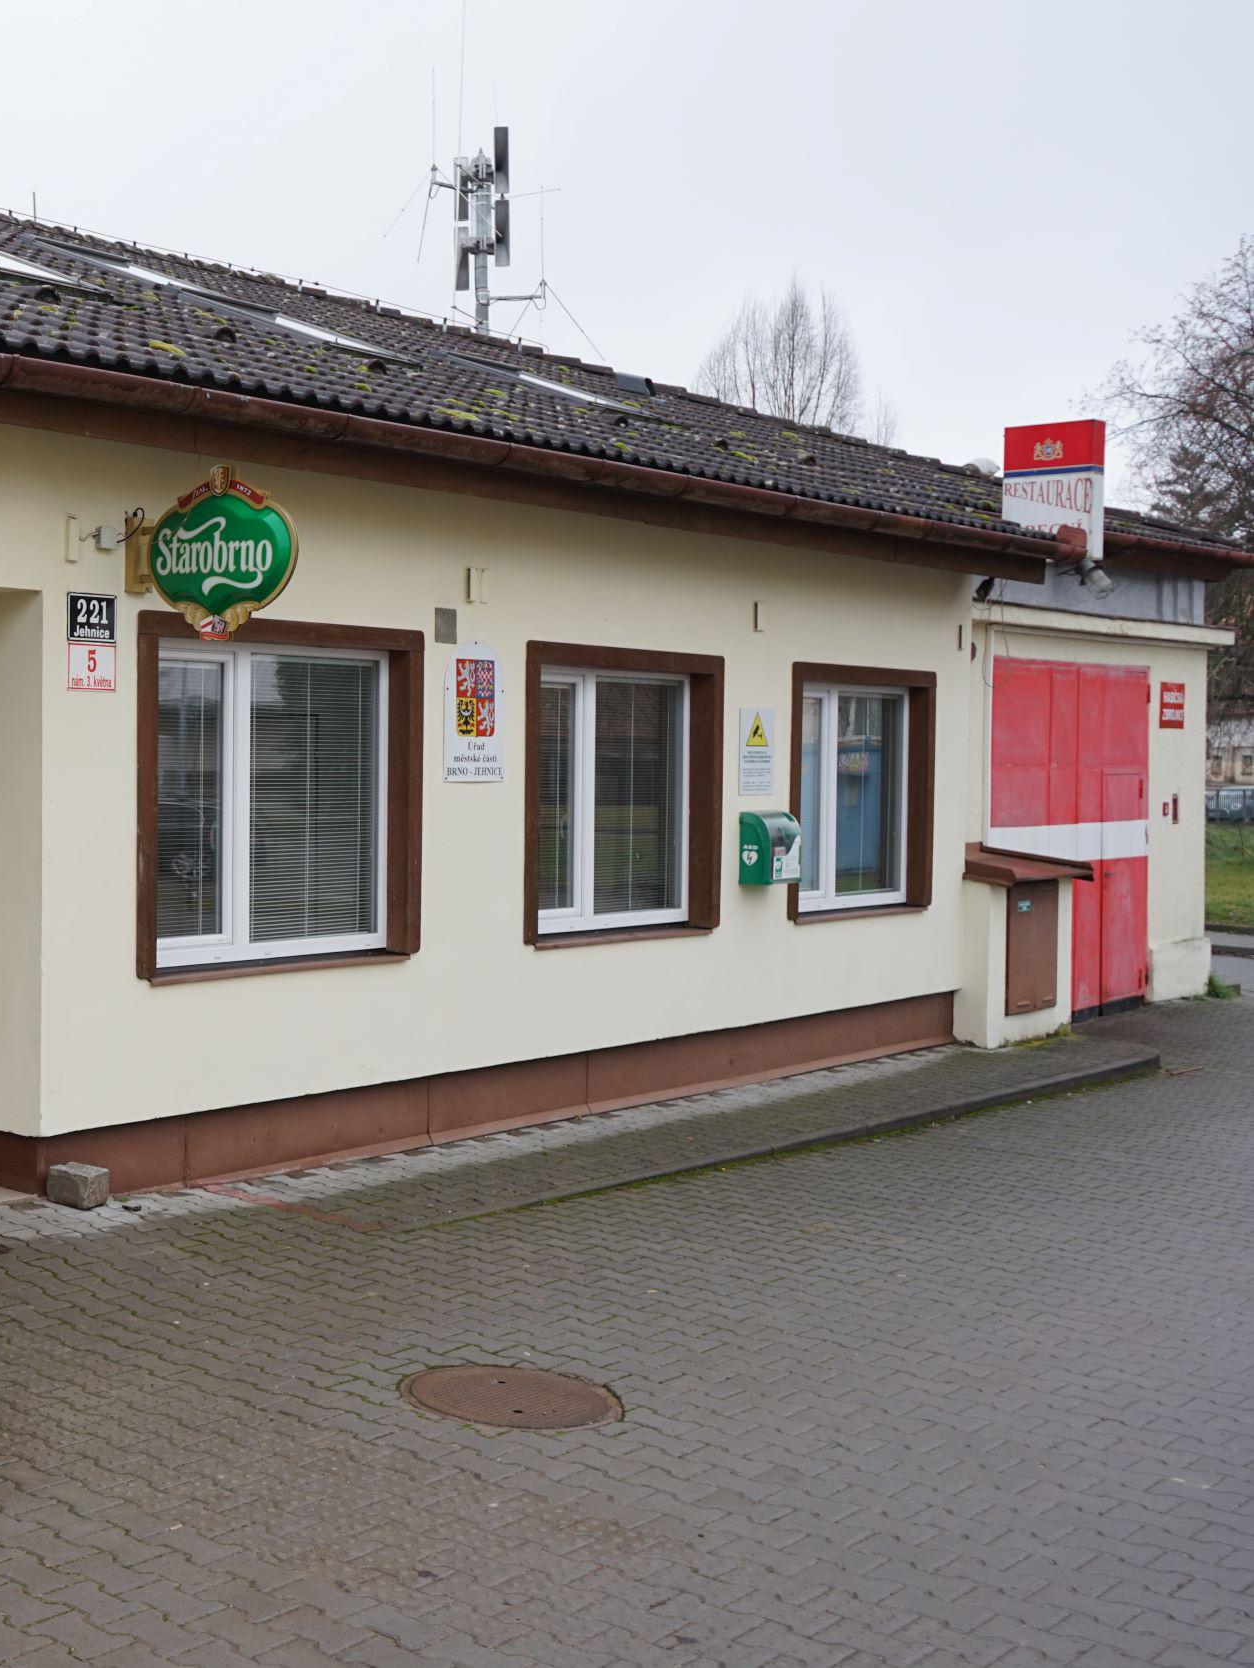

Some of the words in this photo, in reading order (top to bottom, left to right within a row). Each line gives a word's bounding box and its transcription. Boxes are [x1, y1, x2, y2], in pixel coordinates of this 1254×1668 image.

[1004, 477, 1092, 514] RESTAURACE
[156, 516, 273, 596] Starobrno
[77, 599, 109, 625] 221
[74, 624, 110, 639] Jehnice
[87, 649, 97, 673] 5
[467, 739, 485, 751] Úřad
[447, 766, 468, 776] BRNO
[473, 766, 502, 776] JEHNICE
